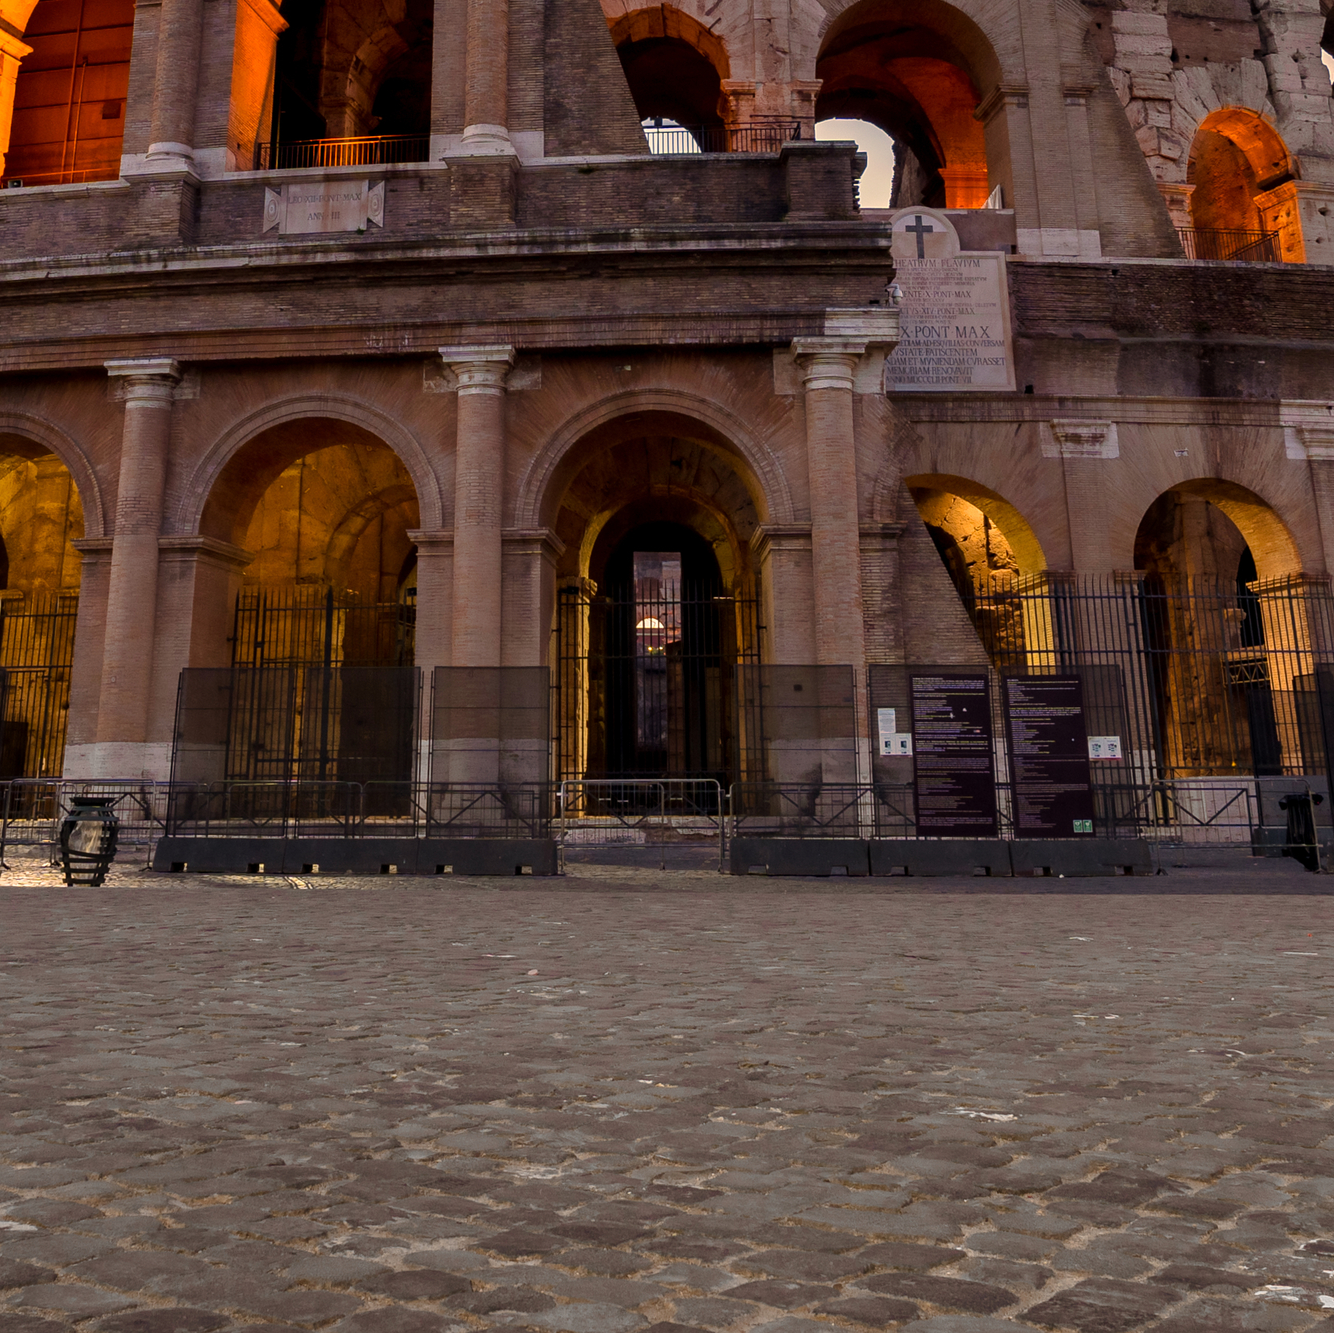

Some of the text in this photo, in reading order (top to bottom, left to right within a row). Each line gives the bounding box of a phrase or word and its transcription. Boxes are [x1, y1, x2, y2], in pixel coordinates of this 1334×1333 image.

[288, 195, 303, 204] LEO
[318, 193, 342, 203] PONT
[343, 192, 362, 202] MAX
[331, 211, 341, 220] III
[941, 259, 981, 268] FLAVIVM
[902, 290, 972, 298] ENTE X PONT MAX
[898, 307, 919, 315] CTVS
[936, 307, 956, 315] PONT
[957, 307, 976, 315] MAX
[900, 325, 991, 338] X PONT MAX
[898, 339, 922, 347] EDIAM
[965, 339, 1005, 348] CONVERSAM
[893, 347, 978, 357] VSTATE FATISCENTEM
[885, 357, 1006, 366] NDAM ET MVNIENDAM CVRASSET
[886, 366, 974, 376] MEMORIAM RENOVAVIT
